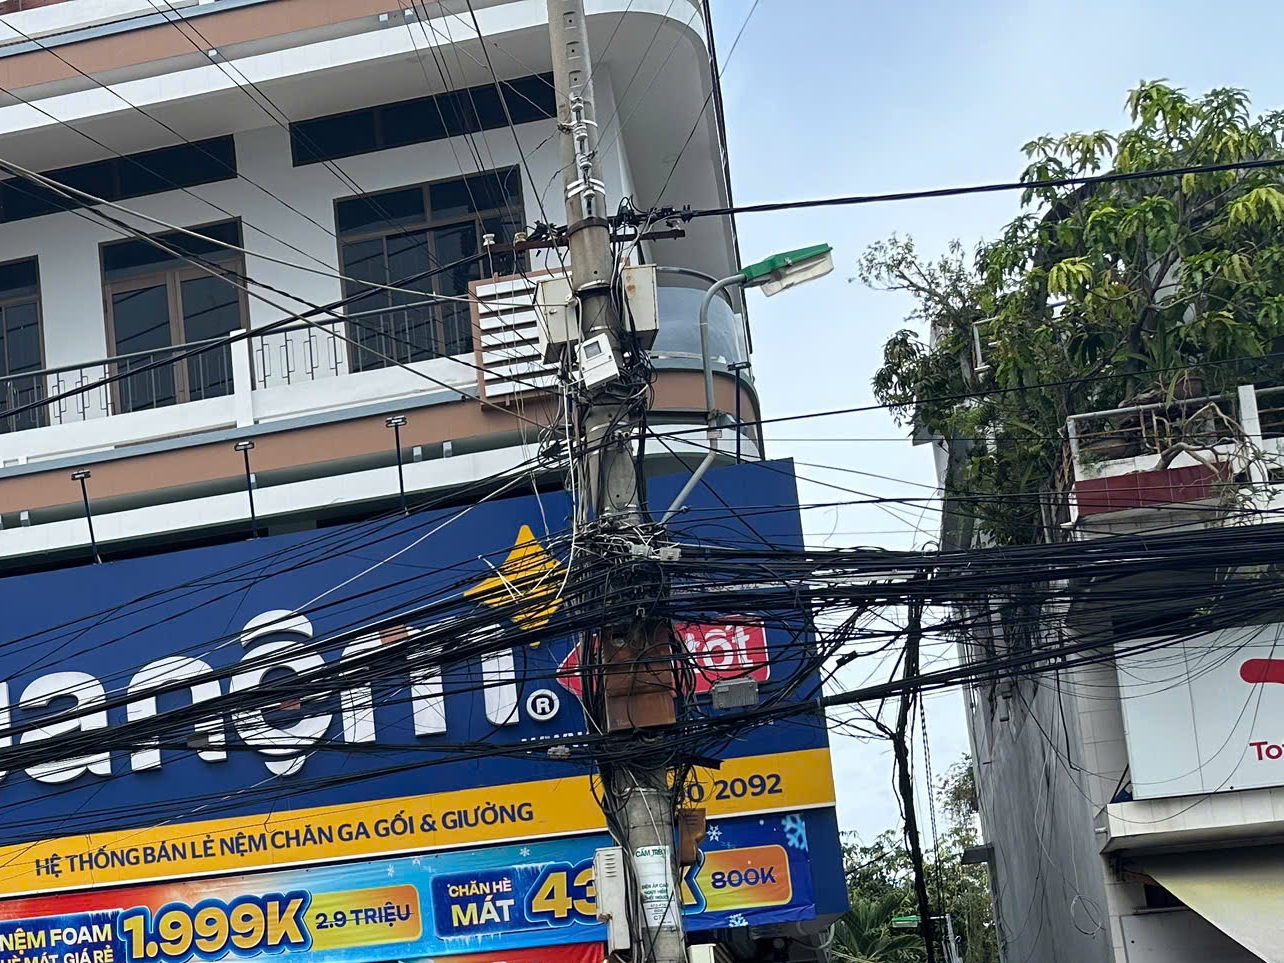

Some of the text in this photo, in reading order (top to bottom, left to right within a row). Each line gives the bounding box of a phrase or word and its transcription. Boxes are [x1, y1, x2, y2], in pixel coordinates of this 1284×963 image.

[716, 772, 783, 801] 2092
[35, 802, 534, 877] HỆ THỐNG BÁN LẺ NỆM CHĂN GA GỐI & GIƯỜNG
[448, 876, 512, 899] CHĂN HÈ
[451, 895, 515, 927] MÁT
[50, 923, 113, 947] FOAM
[122, 896, 305, 962] 1.999K
